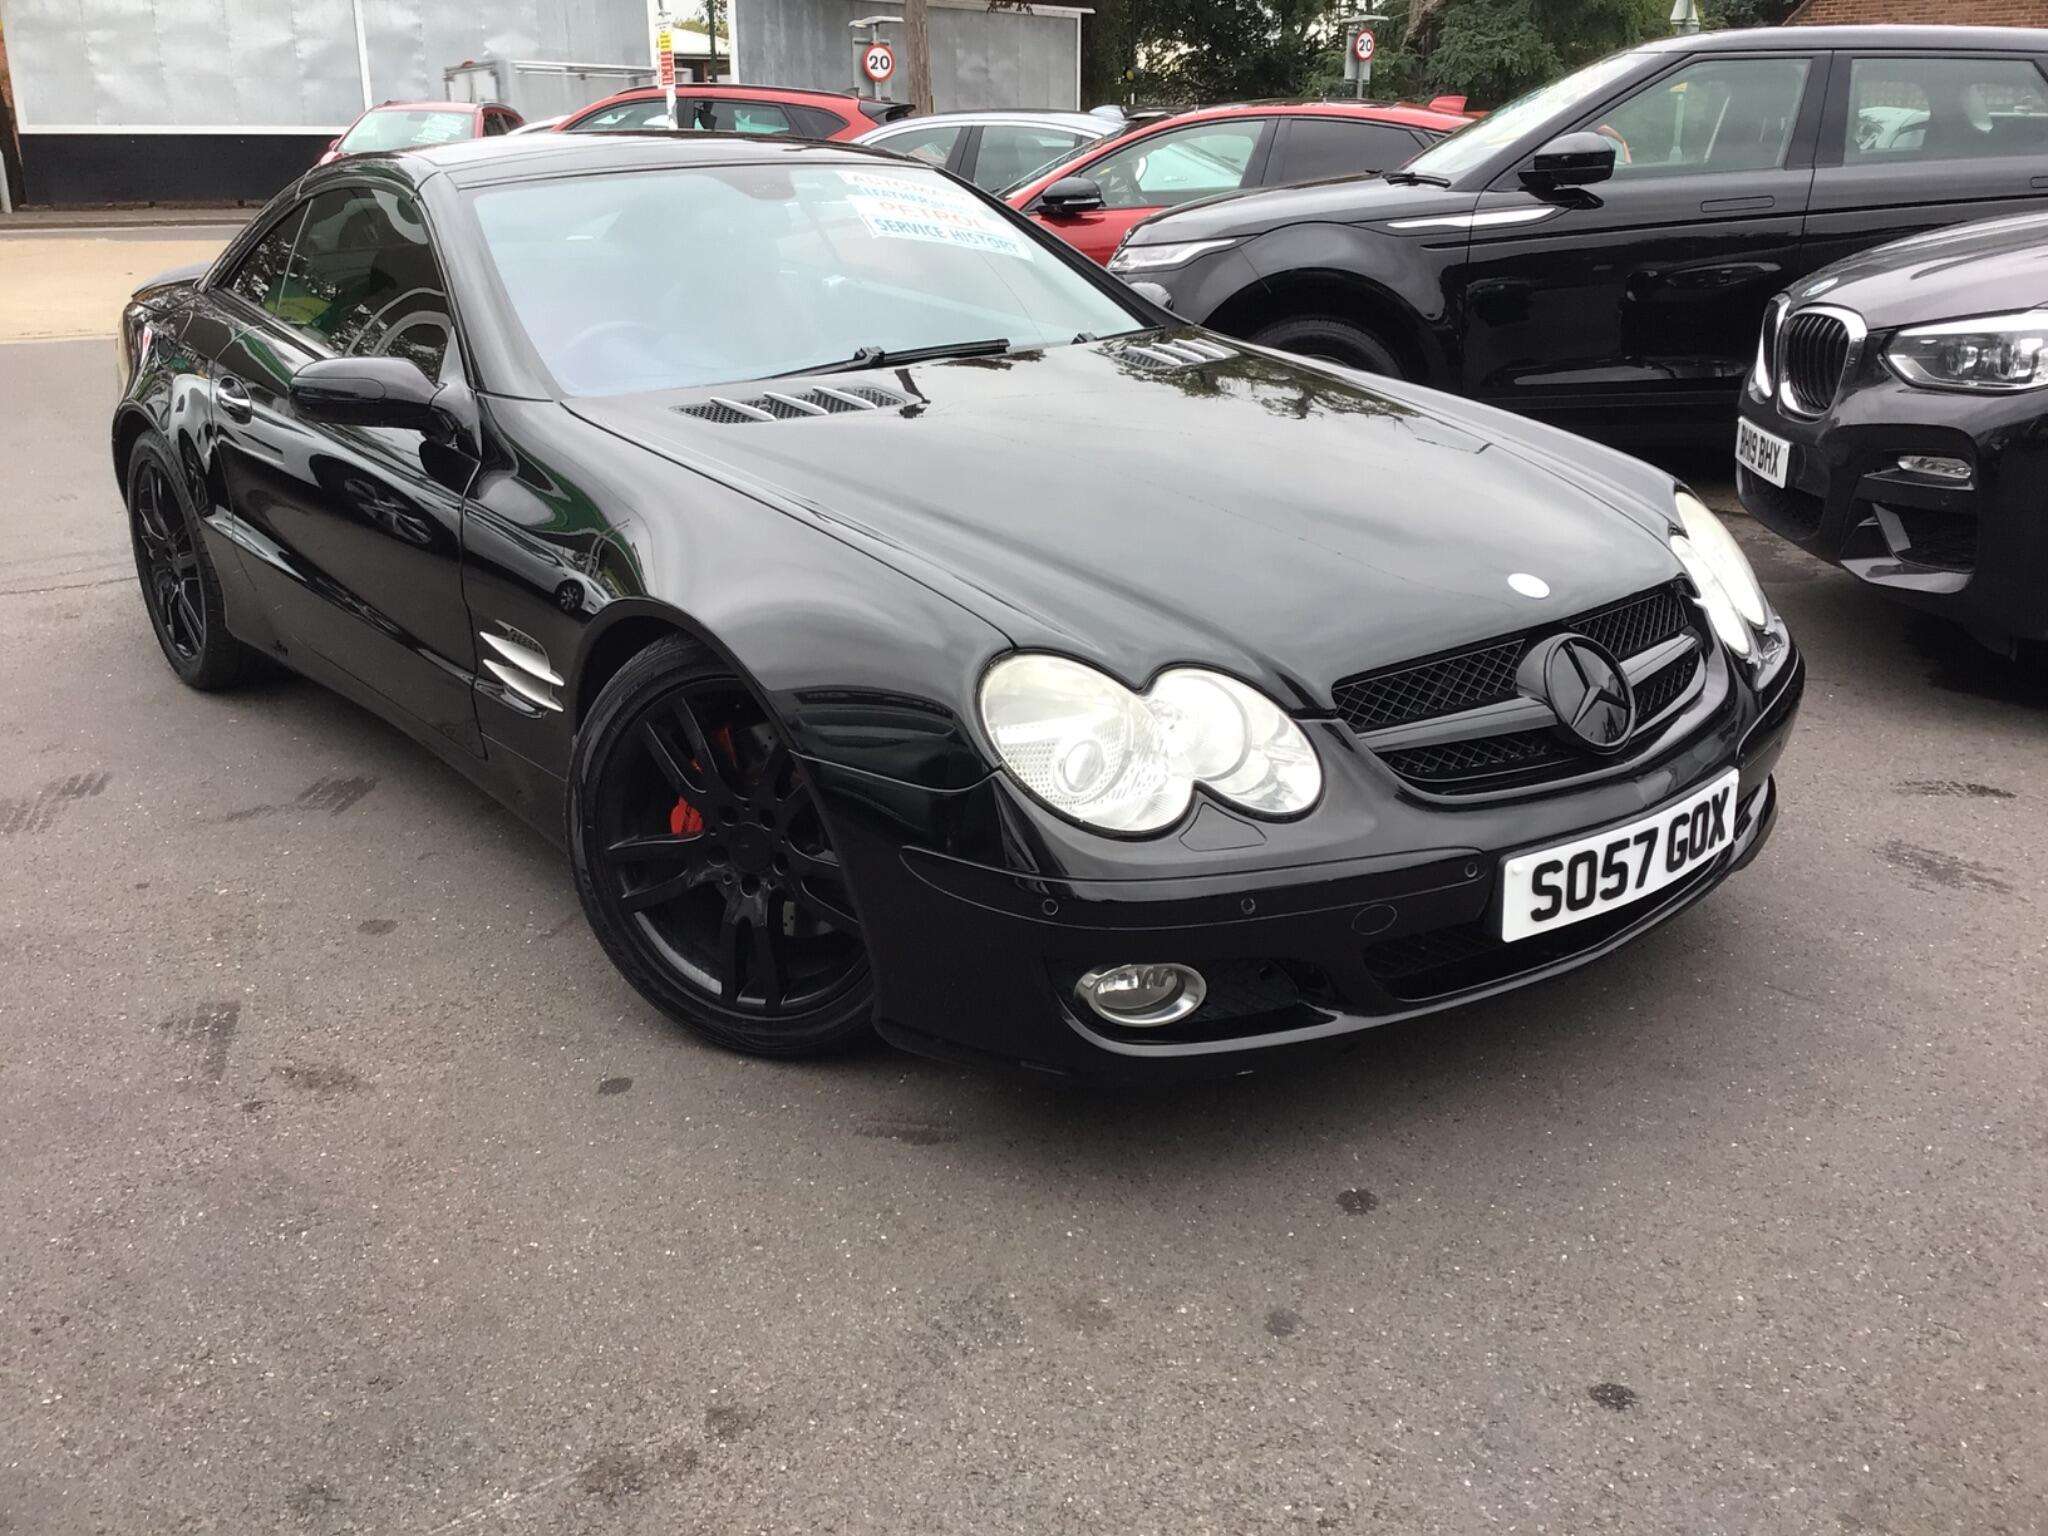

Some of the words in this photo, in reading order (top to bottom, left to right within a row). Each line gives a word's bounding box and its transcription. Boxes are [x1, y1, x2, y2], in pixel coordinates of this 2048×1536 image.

[1359, 38, 1373, 52] 20
[869, 55, 890, 70] 20
[878, 201, 984, 229] PETROL
[873, 218, 948, 240] SERVICE
[949, 228, 1019, 253] HISTORY
[1758, 435, 1781, 478] BHX
[1530, 827, 1659, 922] SO57
[1666, 786, 1730, 873] GOX
